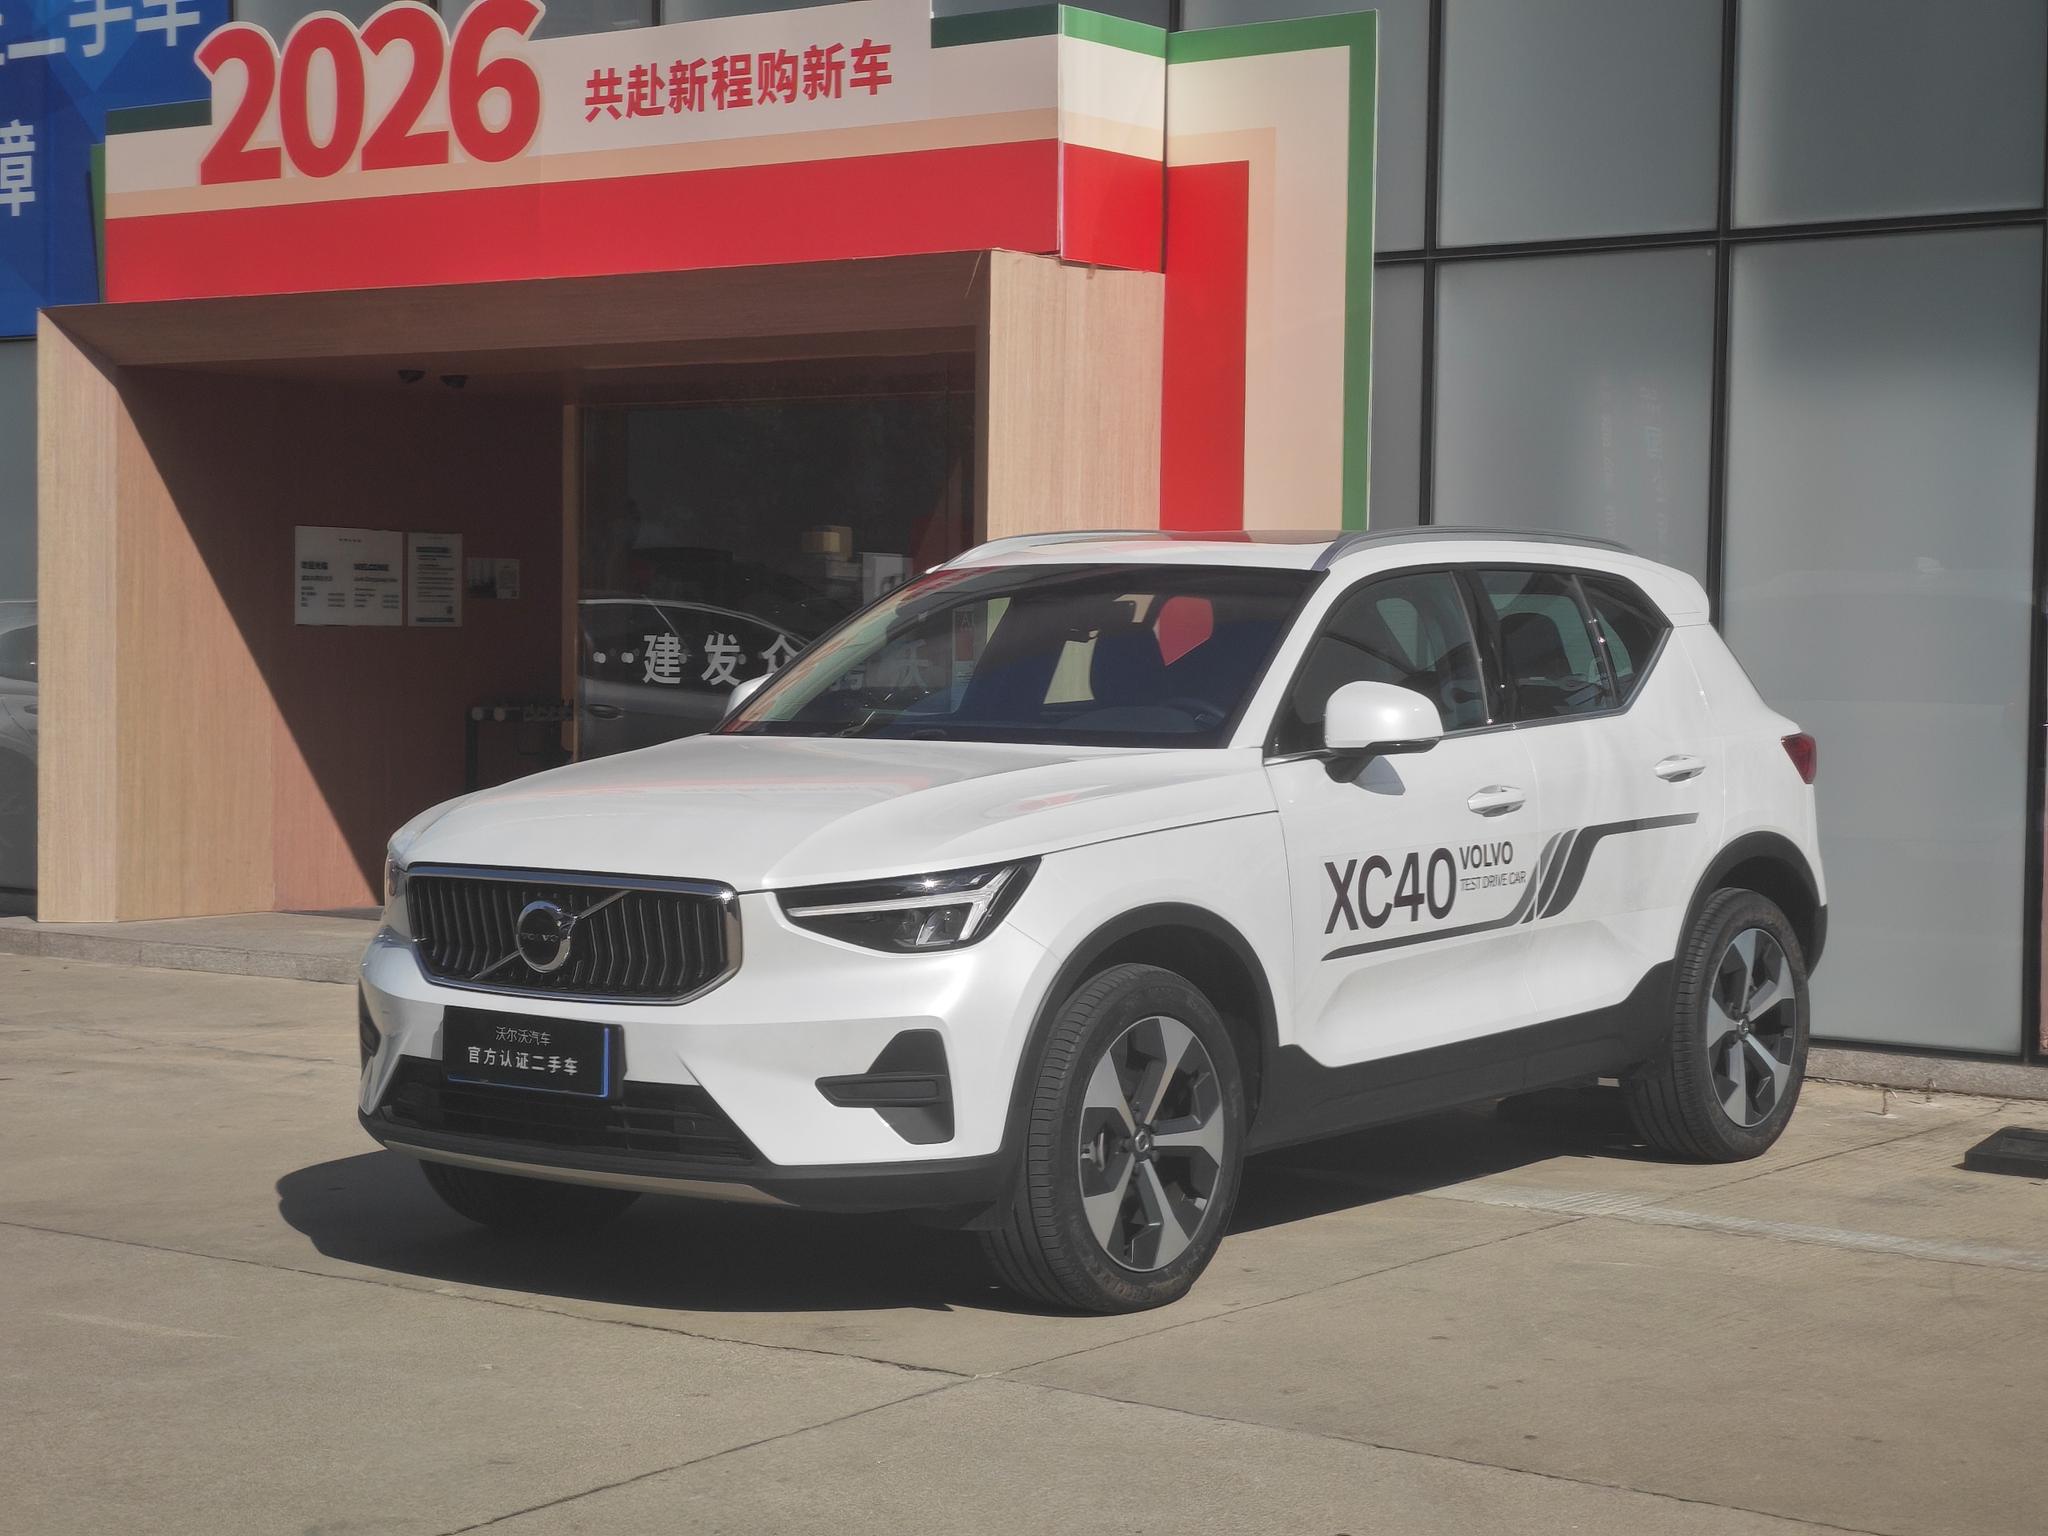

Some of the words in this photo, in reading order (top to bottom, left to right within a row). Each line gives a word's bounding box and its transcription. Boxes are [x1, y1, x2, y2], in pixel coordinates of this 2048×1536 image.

[198, 0, 541, 186] 2026
[584, 38, 893, 124] 共赴新程购新车
[1324, 847, 1457, 935] XC40
[1459, 841, 1513, 869] VOLVO
[1459, 876, 1482, 891] TEST
[1482, 873, 1509, 889] DRIVE
[1508, 870, 1527, 885] CAR
[468, 1046, 578, 1075] 官方认证二手车
[495, 1025, 552, 1047] 沃尔沃汽车
